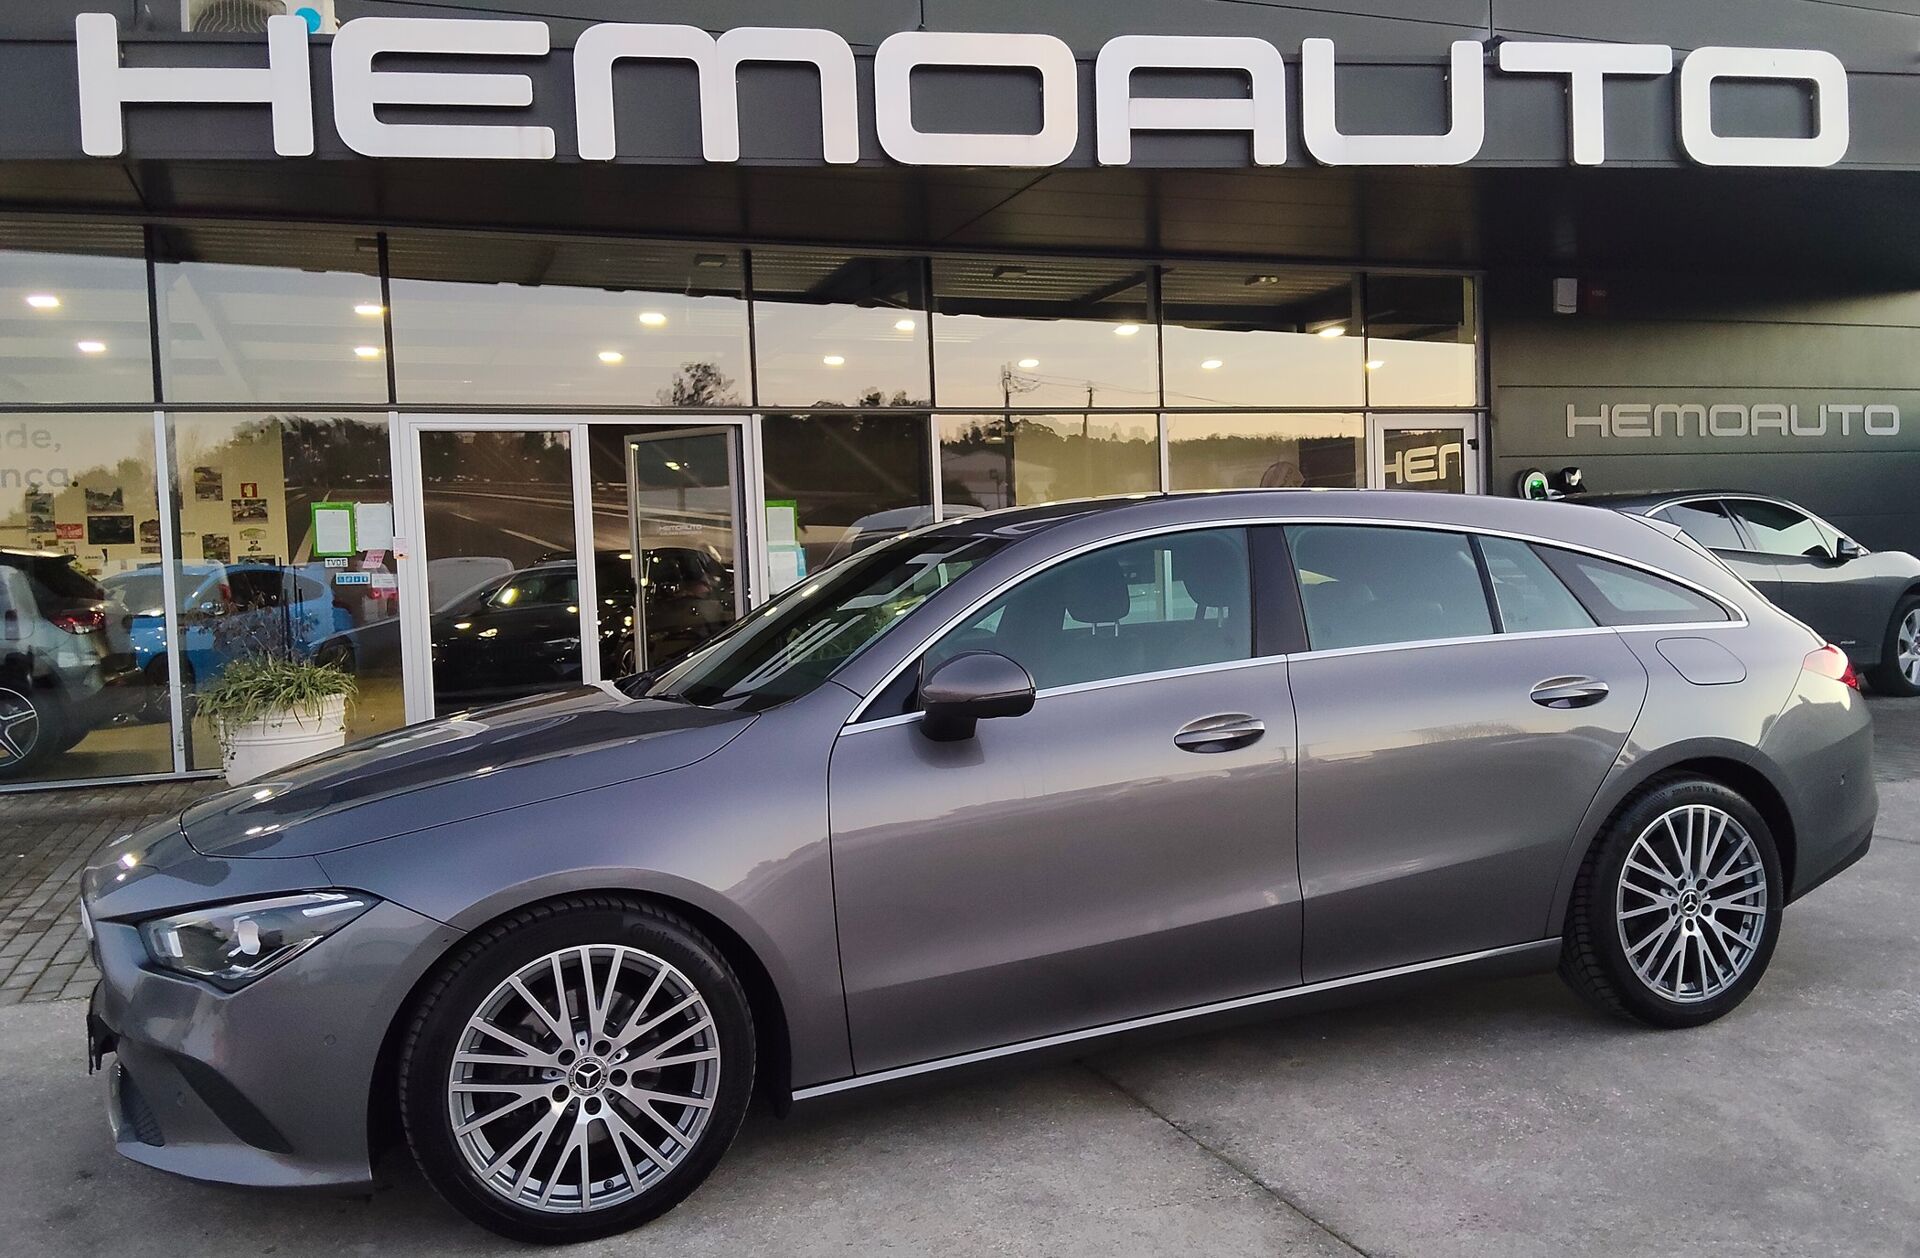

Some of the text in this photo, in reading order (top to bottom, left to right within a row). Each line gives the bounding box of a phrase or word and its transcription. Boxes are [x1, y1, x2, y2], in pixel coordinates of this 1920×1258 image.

[76, 13, 1850, 168] HEMOAUTO
[1566, 403, 1900, 437] HEMOAUTO
[0, 423, 61, 452] de,
[326, 559, 348, 567] TVDE
